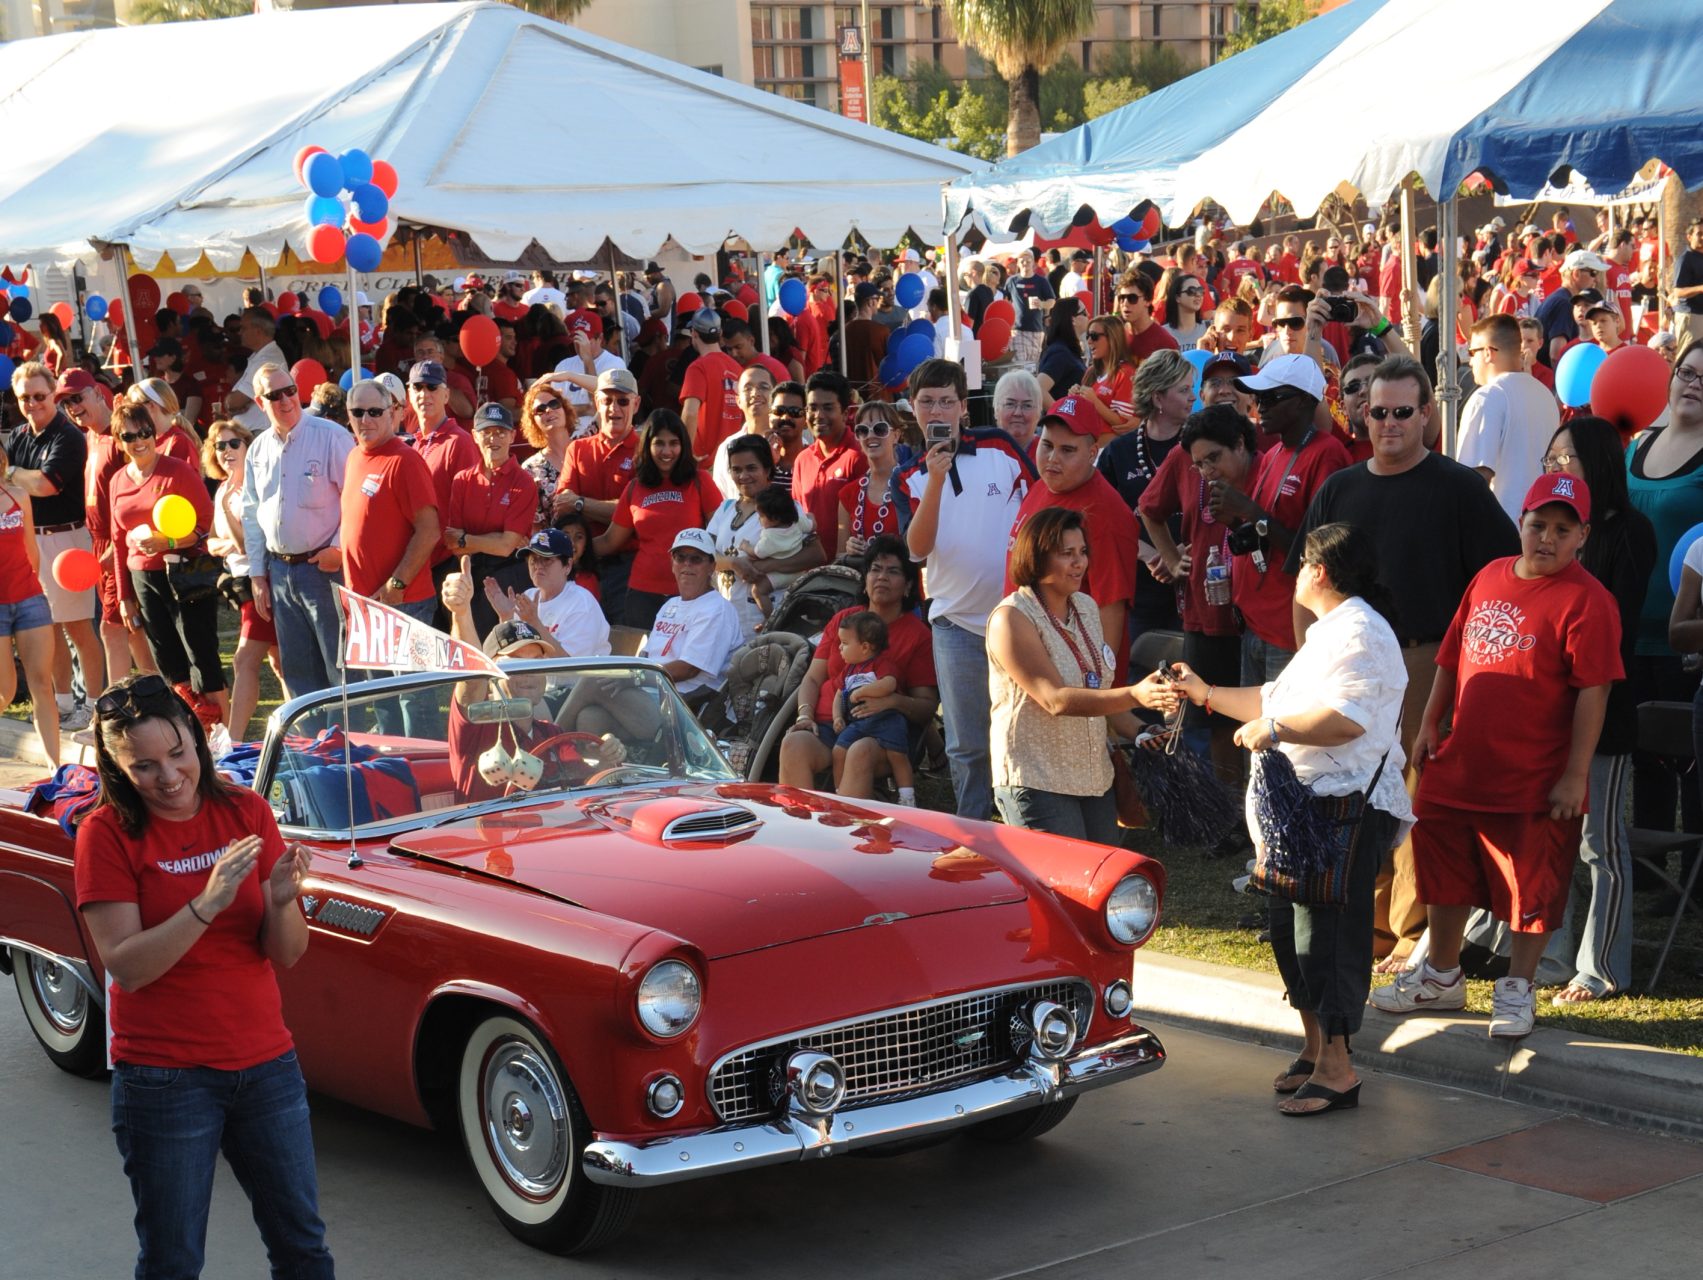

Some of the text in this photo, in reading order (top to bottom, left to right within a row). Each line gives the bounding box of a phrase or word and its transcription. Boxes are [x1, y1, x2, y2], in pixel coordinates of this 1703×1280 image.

[842, 28, 861, 54] A
[1057, 399, 1077, 416] A
[987, 483, 1000, 496] A
[1552, 478, 1575, 499] A
[642, 491, 684, 508] ARIZONA
[1473, 600, 1526, 626] ARIZONA
